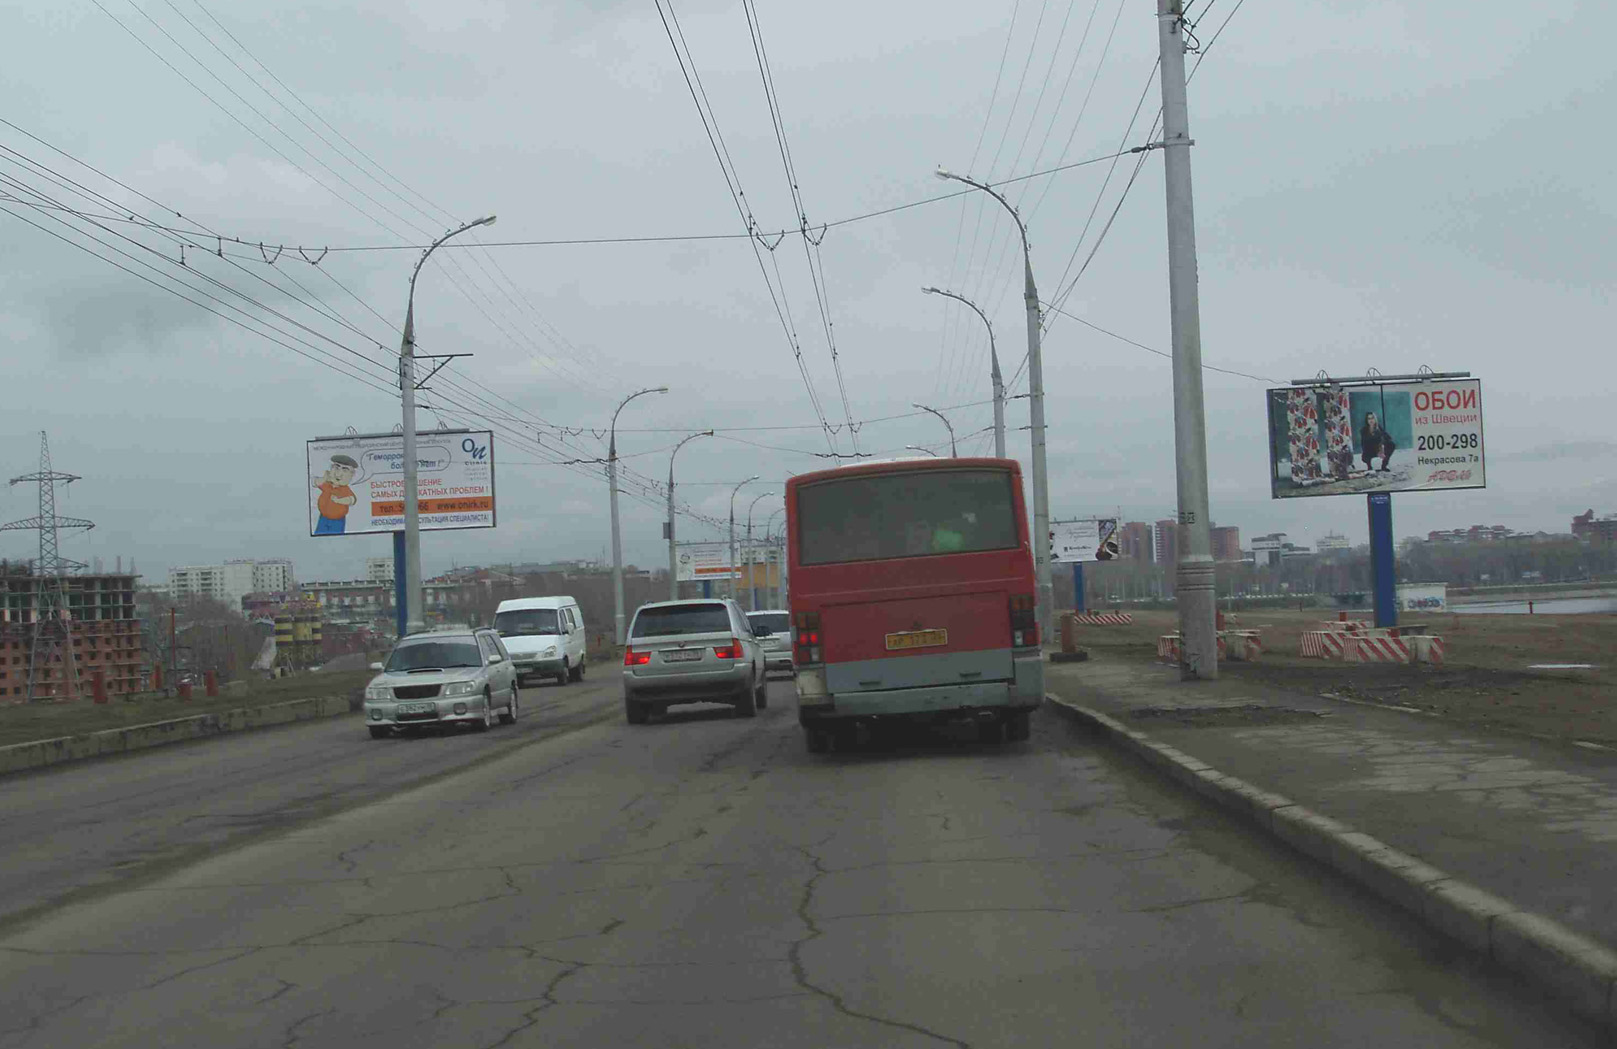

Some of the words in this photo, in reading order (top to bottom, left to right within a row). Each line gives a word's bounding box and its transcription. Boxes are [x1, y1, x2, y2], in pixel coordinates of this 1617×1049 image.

[1414, 389, 1476, 411] ОБОИ
[1415, 416, 1429, 425] из
[1431, 414, 1477, 424] Швеции
[1417, 433, 1478, 451] 200-298
[1417, 456, 1466, 467] Некрасова
[1468, 454, 1479, 463] 7а
[371, 490, 398, 499] САМЫХ
[399, 487, 448, 498] ДКАТНЫХ
[449, 485, 485, 495] ПРОБЛЕМ
[371, 517, 405, 527] НЕОБХОДИМ
